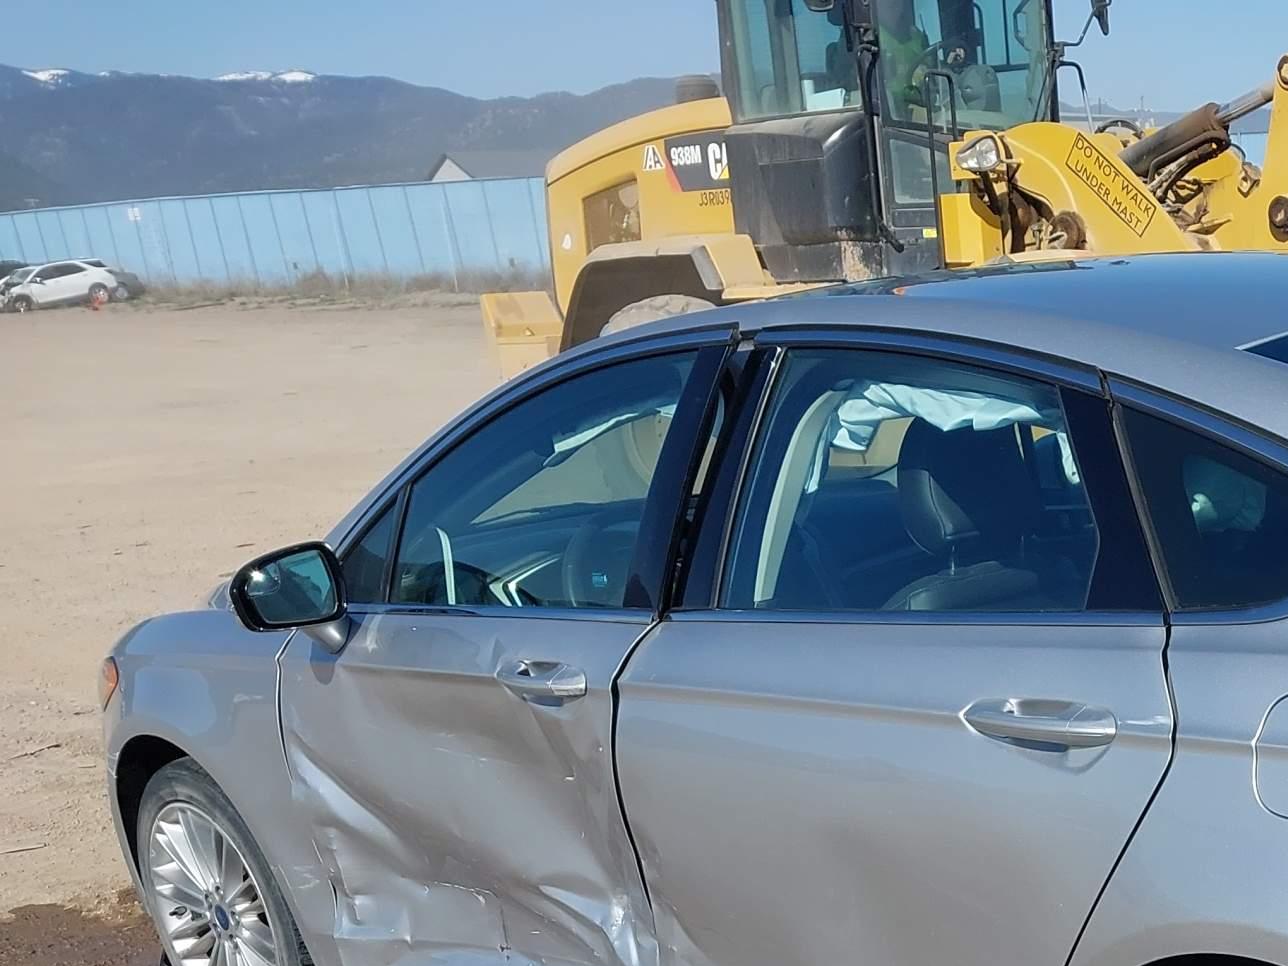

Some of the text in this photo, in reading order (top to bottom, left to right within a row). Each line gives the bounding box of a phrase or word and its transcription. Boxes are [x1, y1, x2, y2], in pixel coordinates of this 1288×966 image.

[670, 144, 702, 166] 938M
[707, 142, 730, 180] CA
[1075, 137, 1152, 218] DO NOT WALK
[1074, 159, 1142, 229] UNDER MAST
